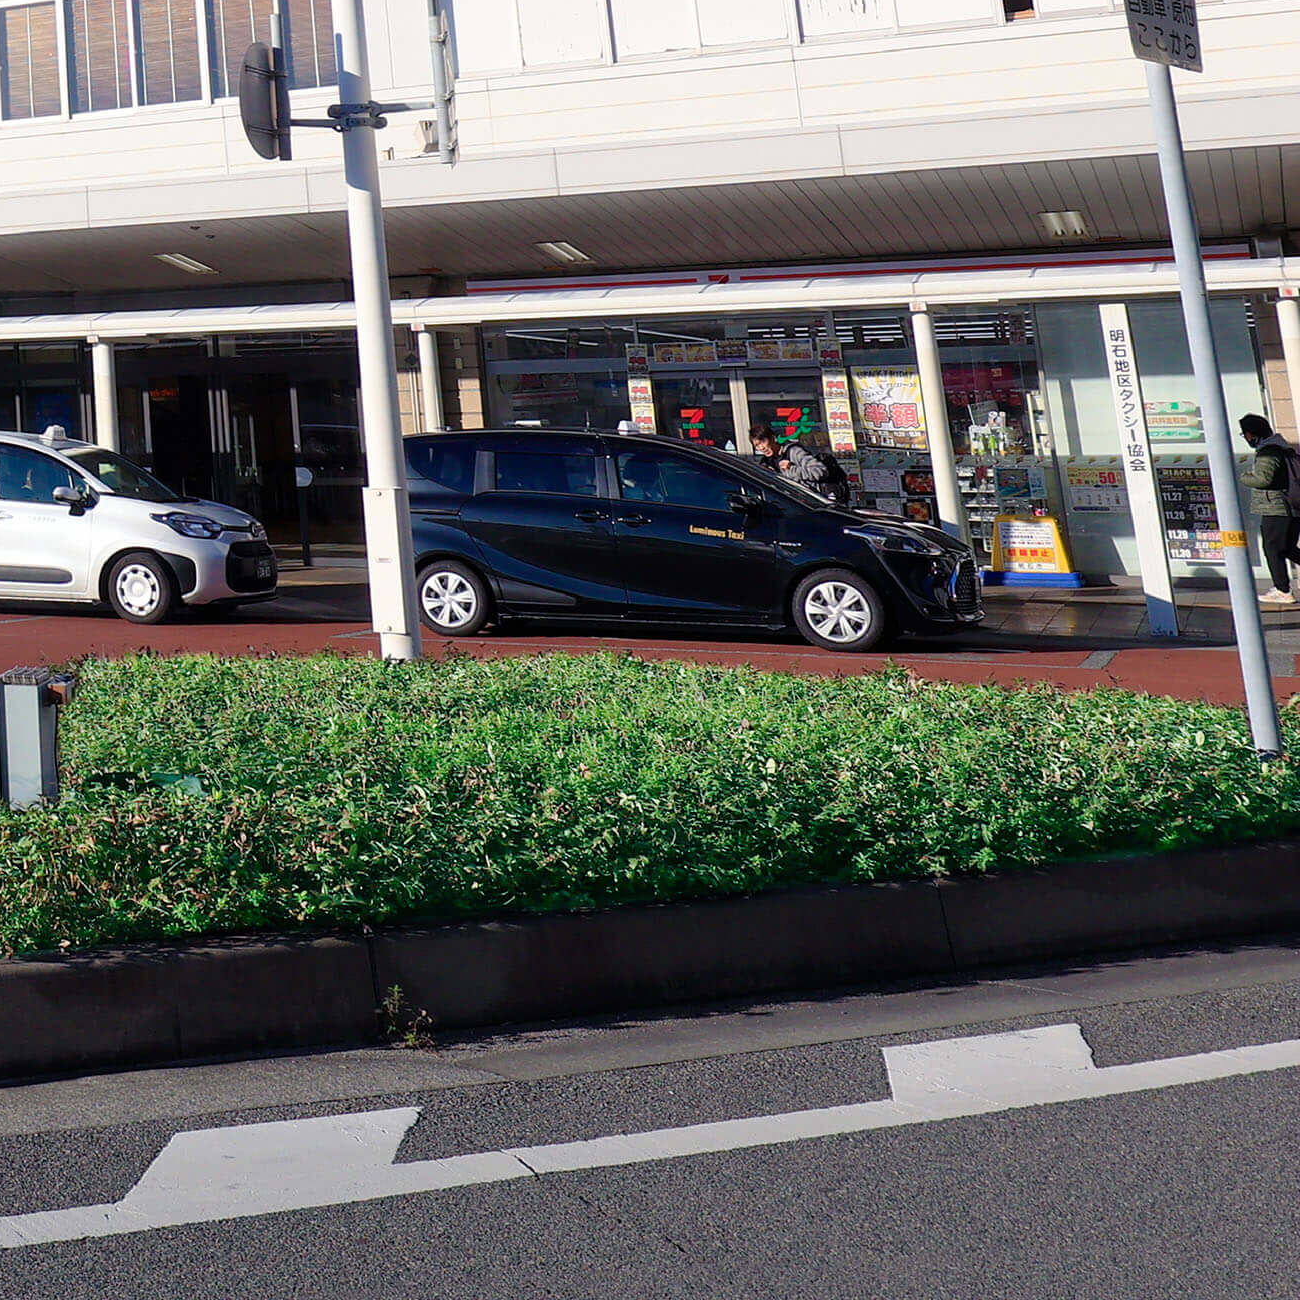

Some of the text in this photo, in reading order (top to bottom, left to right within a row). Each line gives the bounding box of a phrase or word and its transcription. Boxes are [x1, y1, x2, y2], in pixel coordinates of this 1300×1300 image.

[1137, 22, 1197, 60] ここから
[864, 403, 920, 428] 半額
[1109, 329, 1147, 472] 明石地区タクシー協会
[689, 524, 745, 540] Luminous Taxi
